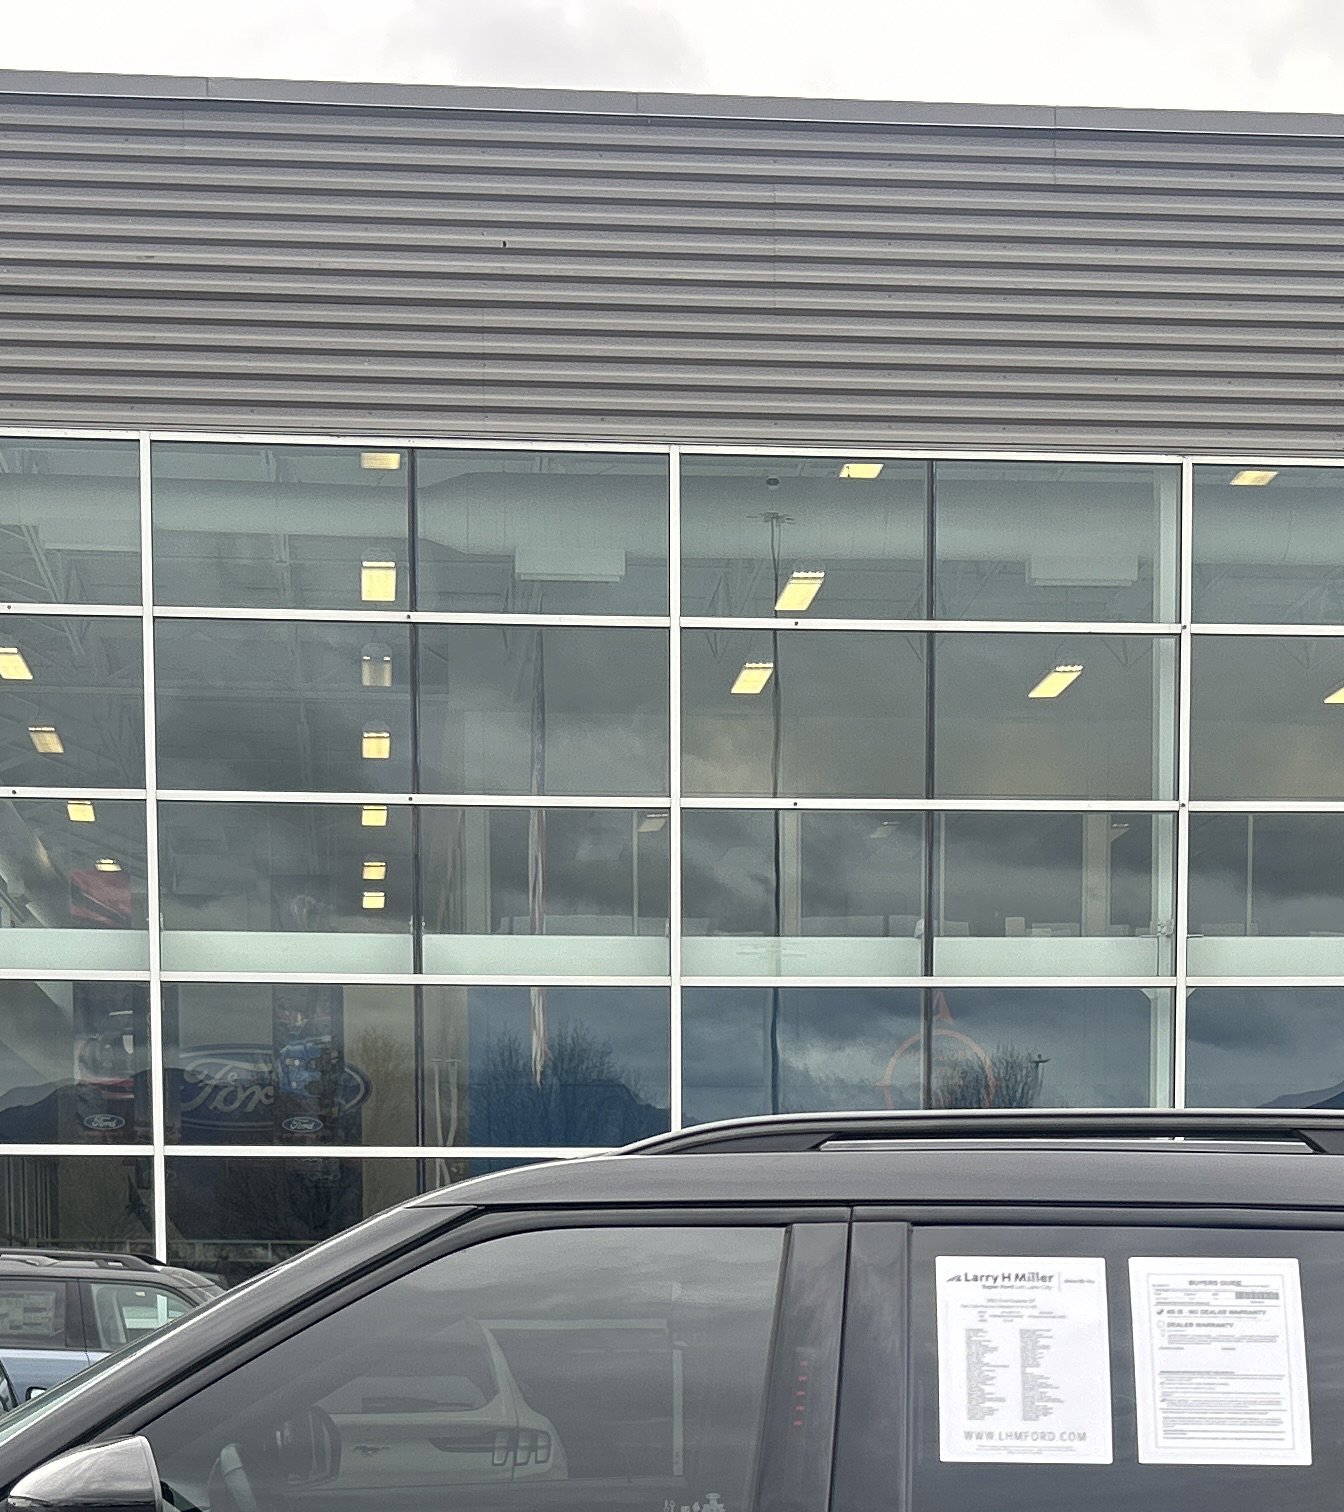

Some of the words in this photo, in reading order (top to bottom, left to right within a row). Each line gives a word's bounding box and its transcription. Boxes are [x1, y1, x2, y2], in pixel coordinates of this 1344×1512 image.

[964, 1272, 999, 1284] Larry
[1002, 1272, 1011, 1282] H
[1014, 1271, 1055, 1283] Miller
